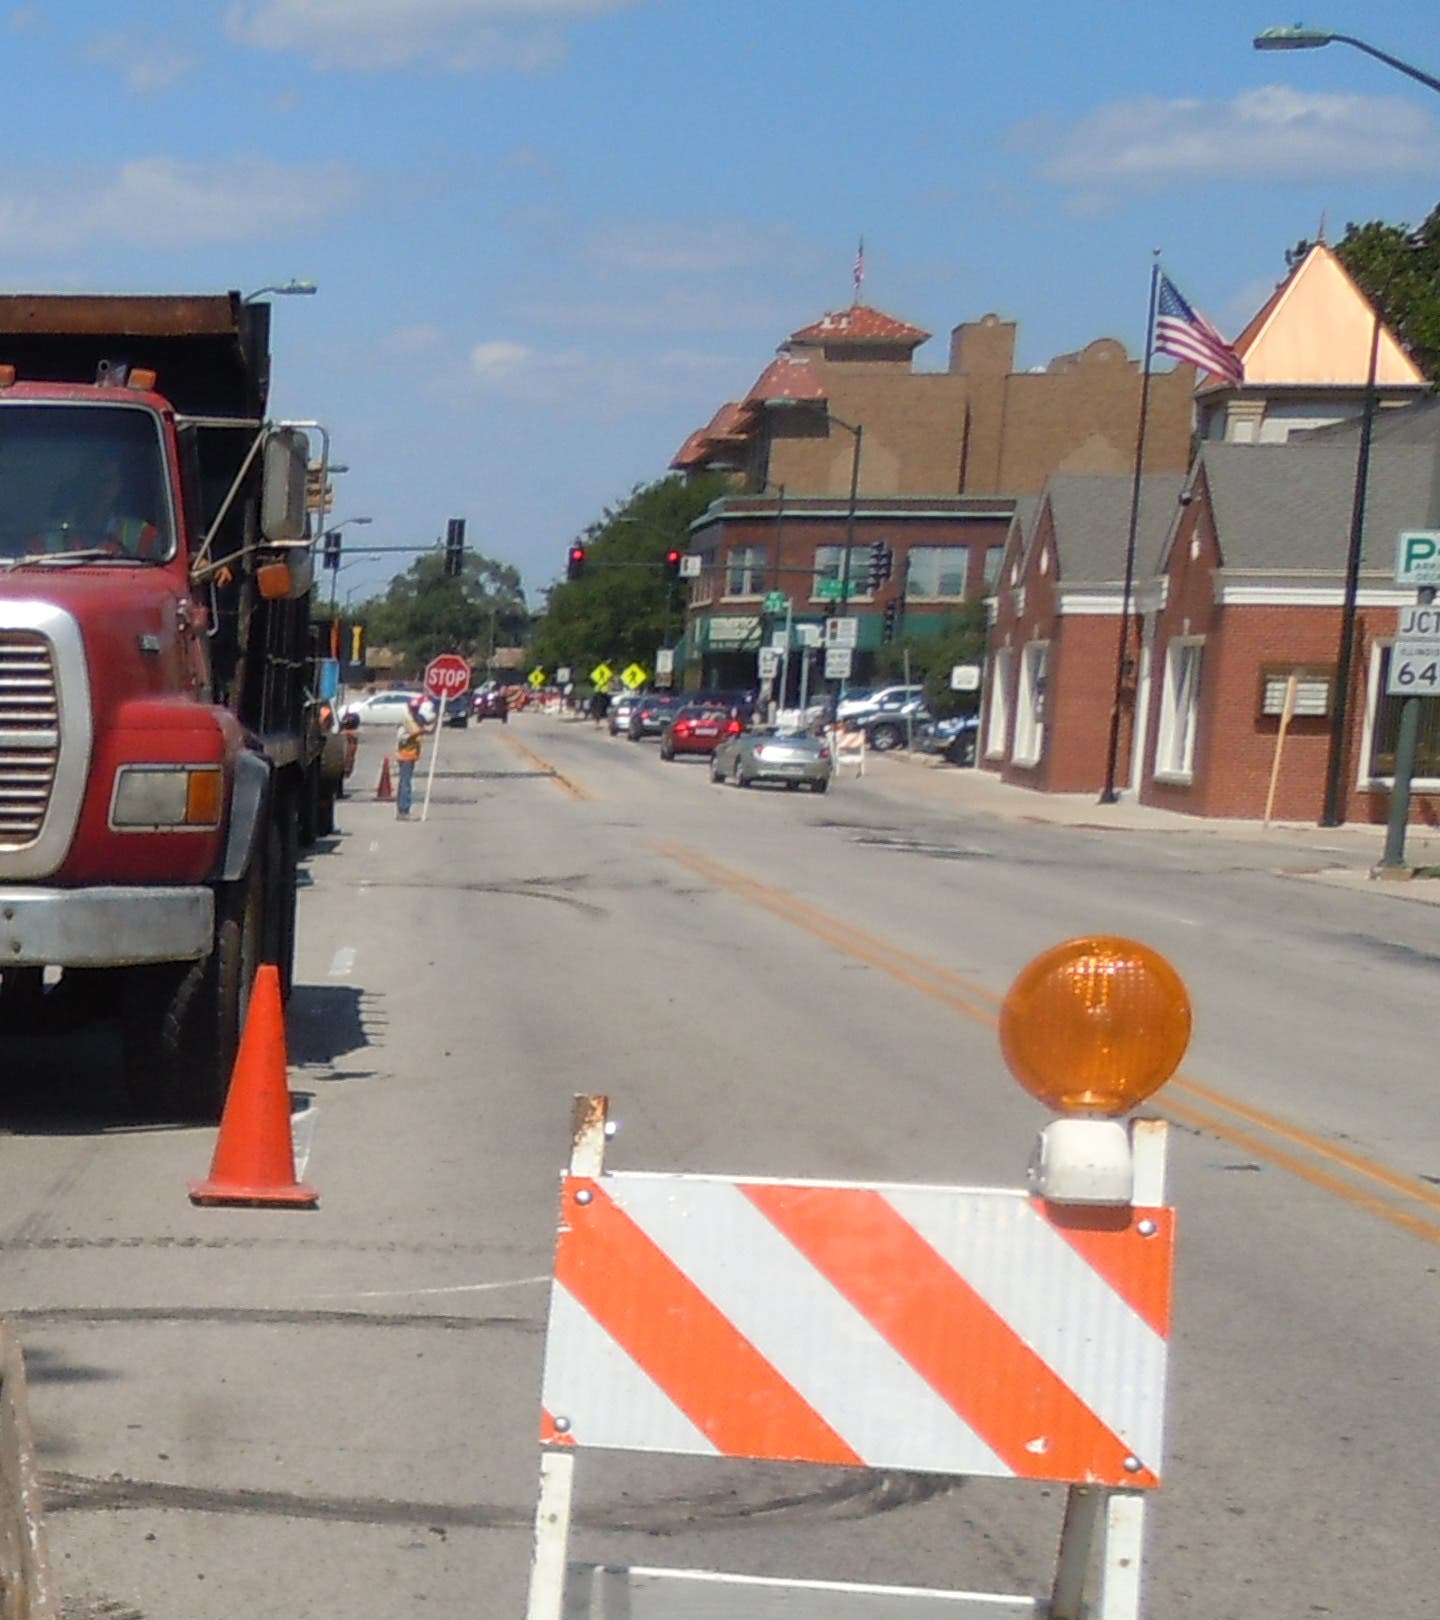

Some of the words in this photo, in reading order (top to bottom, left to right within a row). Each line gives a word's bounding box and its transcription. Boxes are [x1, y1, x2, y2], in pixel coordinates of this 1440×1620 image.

[1402, 611, 1440, 633] JCT
[429, 669, 466, 687] STOP
[1398, 662, 1437, 686] 64
